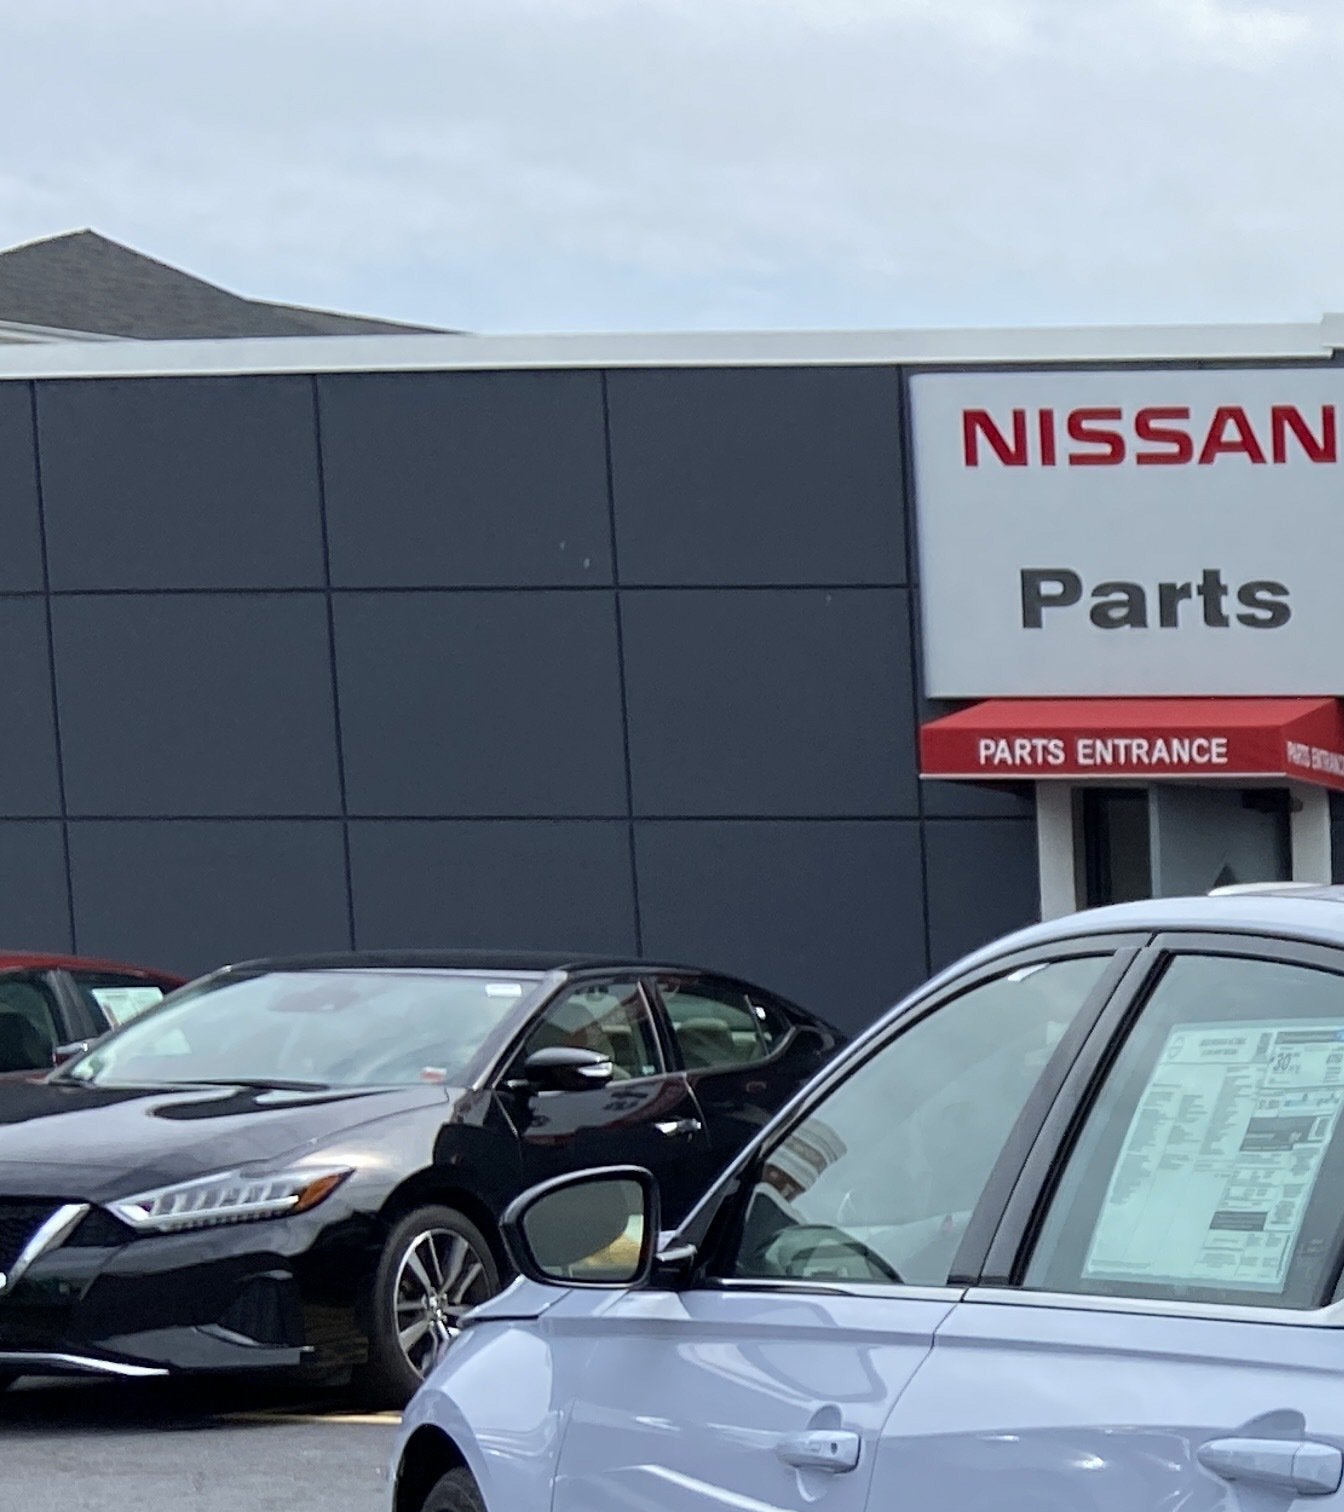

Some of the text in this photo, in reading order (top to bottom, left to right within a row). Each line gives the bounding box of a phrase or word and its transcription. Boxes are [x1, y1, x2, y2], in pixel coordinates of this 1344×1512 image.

[963, 405, 1337, 467] NISSAN
[1019, 568, 1292, 629] Parts
[979, 737, 1228, 766] PARTS ENTRANCE
